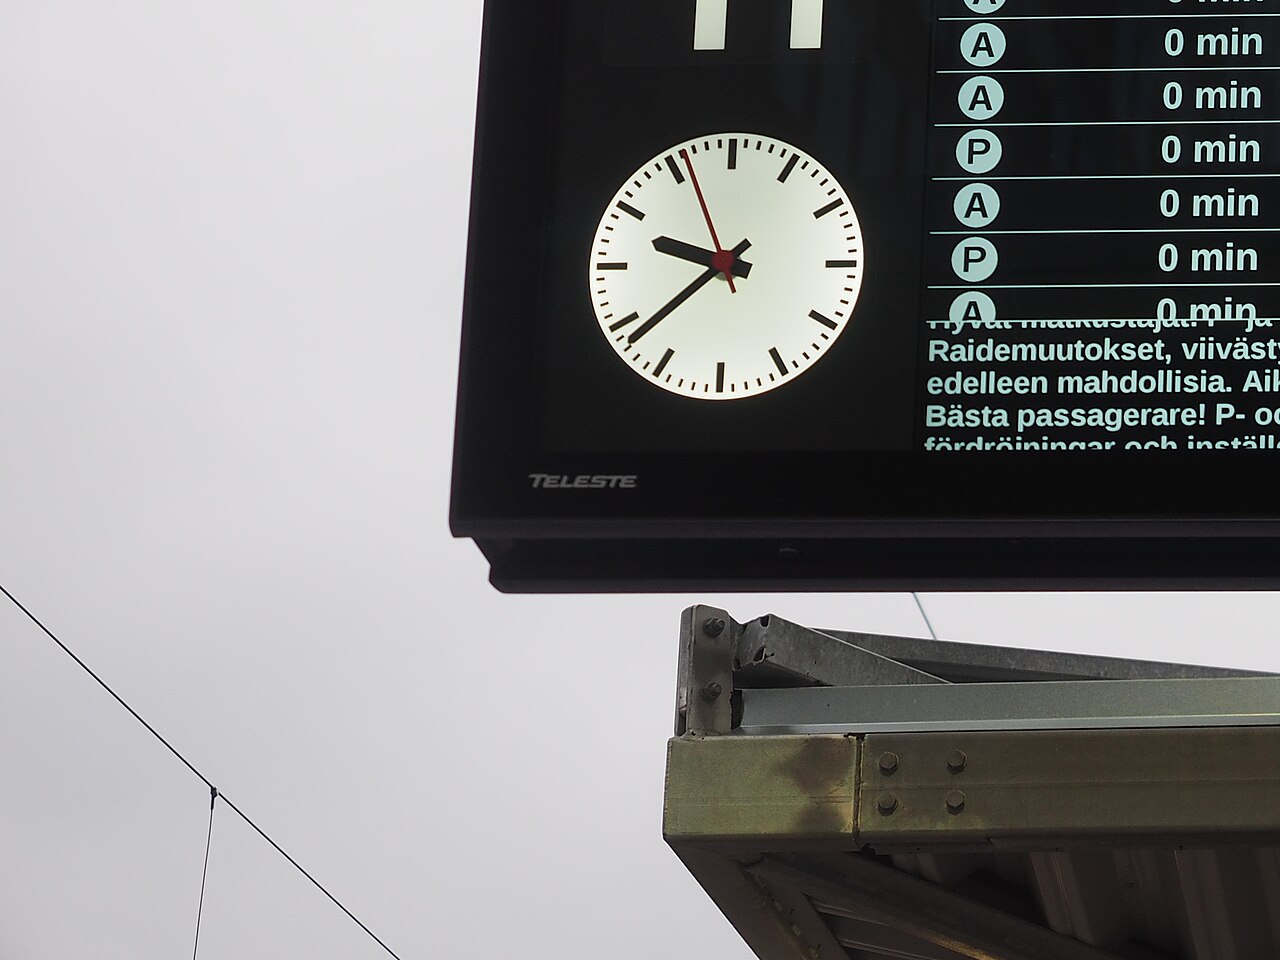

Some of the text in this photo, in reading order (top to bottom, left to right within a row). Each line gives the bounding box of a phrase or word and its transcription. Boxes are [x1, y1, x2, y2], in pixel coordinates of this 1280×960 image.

[970, 30, 995, 58] A
[1165, 29, 1183, 56] 0
[1198, 28, 1262, 55] min
[968, 83, 993, 111] A
[1164, 82, 1182, 109] 0
[1196, 81, 1261, 108] min
[968, 139, 990, 164] P
[1162, 136, 1181, 163] 0
[1195, 134, 1259, 162] min
[964, 191, 989, 219] A
[1160, 190, 1179, 217] 0
[1193, 188, 1258, 216] min
[964, 247, 986, 272] P
[1159, 244, 1178, 271] 0
[1192, 243, 1257, 271] min
[961, 300, 984, 320] A
[1190, 297, 1257, 320] min
[929, 338, 1171, 364] Raidemuutokset,
[928, 371, 1047, 394] edelleen
[1058, 370, 1231, 393] mahdollisia.
[926, 405, 1009, 427] Bästa
[1018, 404, 1205, 432] passagerare!
[1216, 404, 1245, 425] P-
[529, 474, 636, 488] TELESTE
